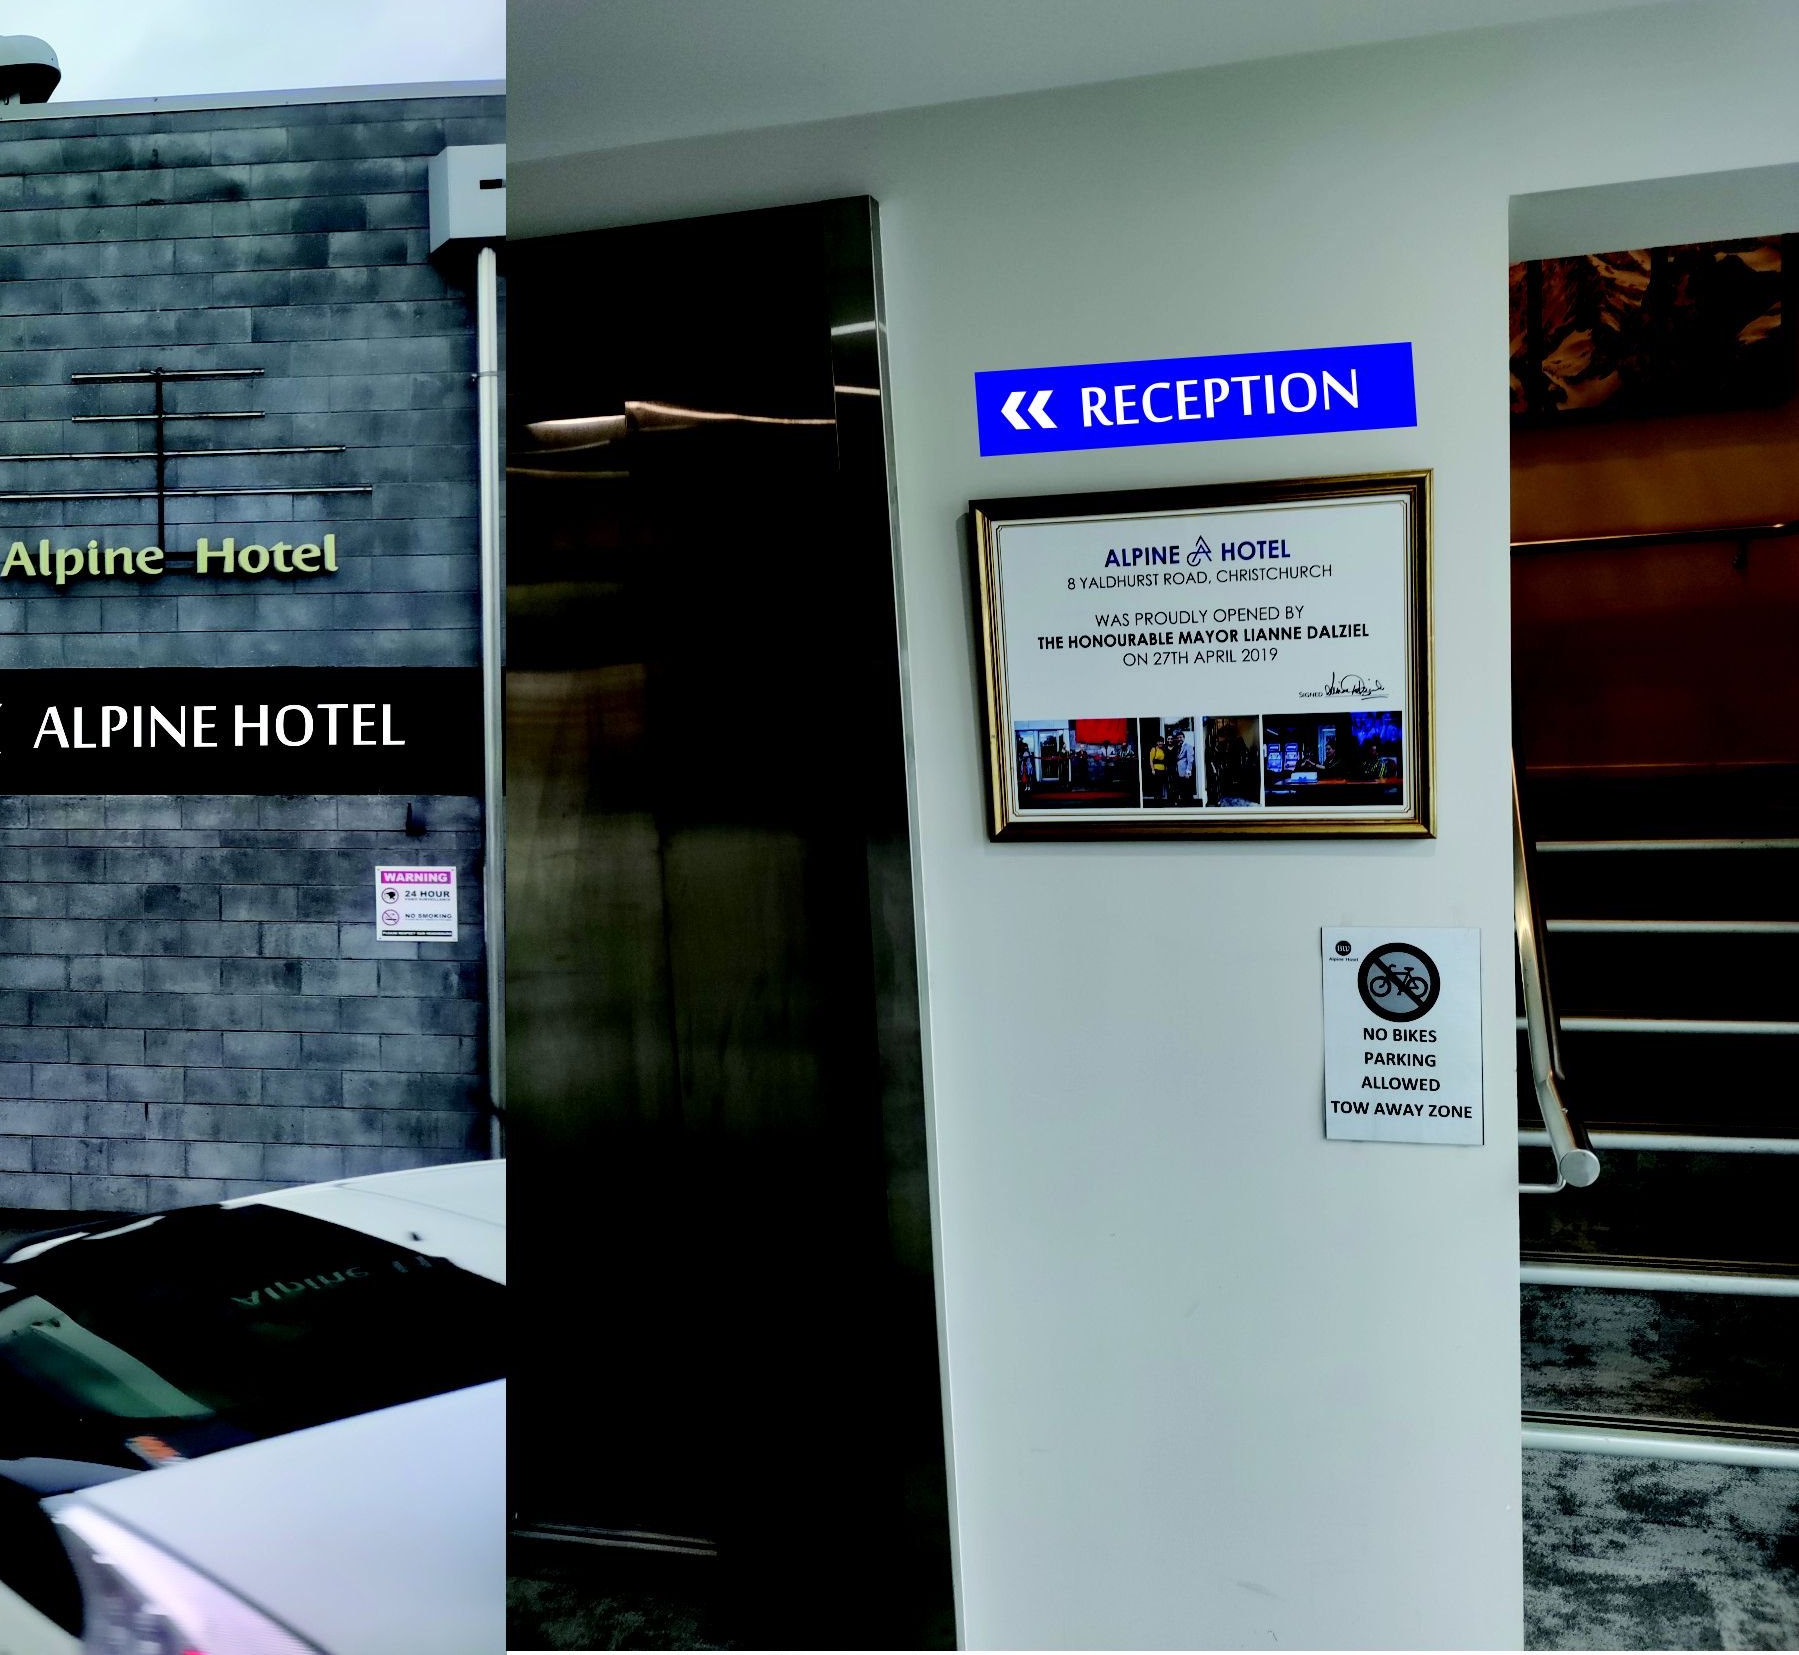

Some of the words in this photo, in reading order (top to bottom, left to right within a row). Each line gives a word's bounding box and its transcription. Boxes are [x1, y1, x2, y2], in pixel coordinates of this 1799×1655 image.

[1080, 368, 1360, 429] RECEPTION
[0, 538, 165, 585] Alpine
[196, 533, 339, 574] Hotel
[1104, 545, 1180, 568] ALPINE
[1221, 539, 1291, 562] HOTEL
[1067, 577, 1076, 591] 8
[1079, 574, 1159, 590] YALDHURST
[1163, 571, 1212, 585] ROAD,
[1216, 564, 1333, 584] CHRISTCHURCH
[1095, 613, 1130, 628] WAS
[1135, 610, 1209, 626] PROUDLY
[1213, 606, 1280, 623] OPENED
[1285, 605, 1305, 620] BY
[1038, 636, 1064, 650] THE
[1068, 631, 1174, 649] HONOURABLE
[1178, 629, 1239, 645] MAYOR
[1244, 627, 1302, 643] LIANNE
[1307, 623, 1370, 640] DALZIEL
[1123, 652, 1148, 667] ON
[1153, 650, 1189, 666] 27TH
[1193, 649, 1237, 665] APRIL
[1241, 647, 1279, 662] 2019
[33, 705, 218, 749] ALPINE
[233, 703, 406, 747] HOTEL
[383, 872, 449, 883] WARNING
[405, 890, 417, 898] 24
[1363, 1028, 1388, 1041] NO
[1393, 1028, 1438, 1043] BIKES
[1364, 1051, 1437, 1067] PARKING
[1361, 1076, 1441, 1092] ALLOWED
[1331, 1100, 1370, 1115] TOW
[1374, 1102, 1424, 1117] AWAY
[1428, 1105, 1473, 1119] ZONE
